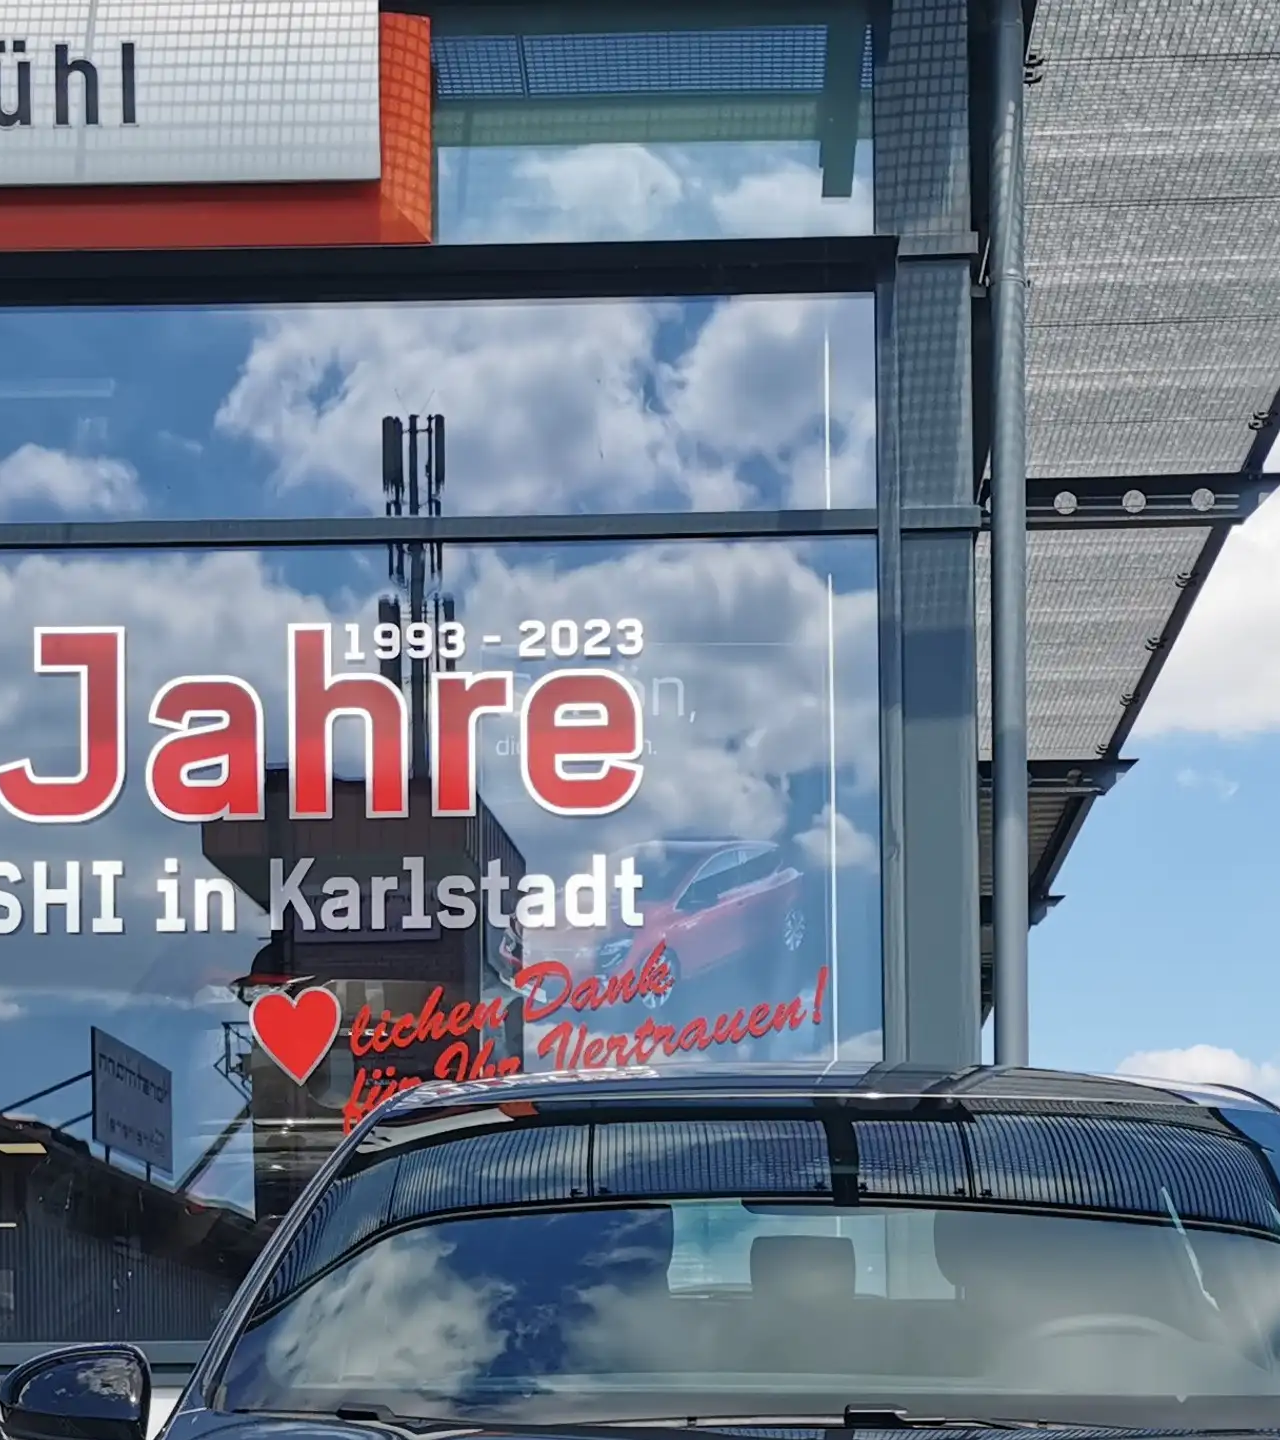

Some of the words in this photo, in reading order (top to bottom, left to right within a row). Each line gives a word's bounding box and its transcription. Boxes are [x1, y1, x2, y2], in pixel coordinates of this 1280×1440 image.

[343, 620, 466, 661] 1993
[518, 618, 644, 658] 2023
[155, 857, 237, 933] in
[270, 853, 645, 931] Karlstadt
[350, 986, 509, 1056] lichen
[515, 939, 675, 1022] Dank
[538, 966, 829, 1069] Vertrauen!
